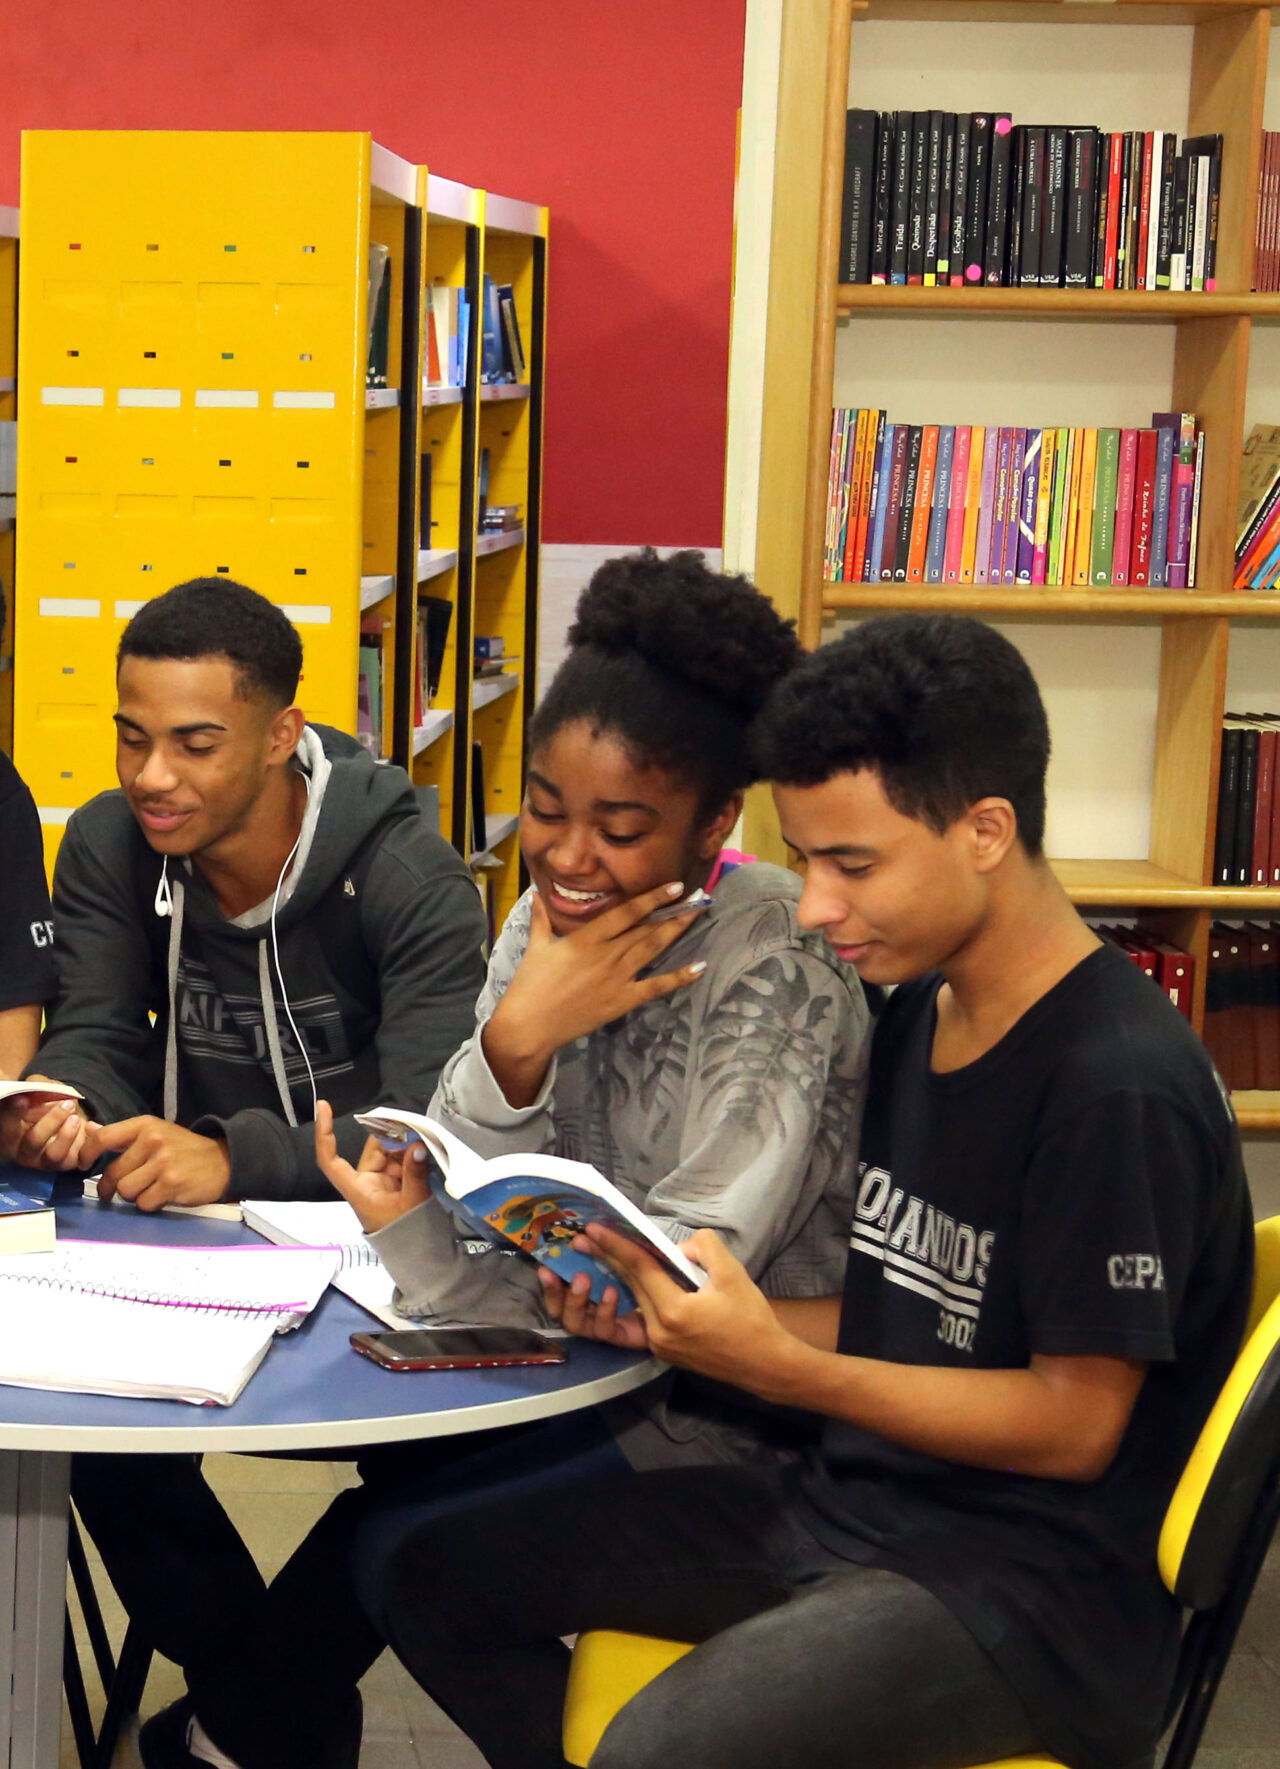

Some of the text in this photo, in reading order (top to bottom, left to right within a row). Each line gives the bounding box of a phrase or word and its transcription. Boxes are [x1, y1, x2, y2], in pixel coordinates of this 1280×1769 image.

[1164, 182, 1173, 226] Formaturas
[875, 220, 885, 253] Marcada
[911, 214, 922, 251] Queimada
[926, 213, 937, 257] Despertada
[953, 215, 963, 254] Escolhida
[890, 464, 902, 502] PRINCESA
[905, 469, 916, 507] PRINCESA
[920, 469, 931, 507] PRINCESA
[937, 470, 948, 508] PRINCESA
[953, 471, 963, 510] PRINCESA
[1027, 475, 1036, 497] Quase
[1103, 465, 1112, 504] PRINCESA
[1120, 473, 1131, 511] PRINCESA
[1158, 473, 1168, 512] PRINCESA
[1142, 490, 1150, 519] Rainha
